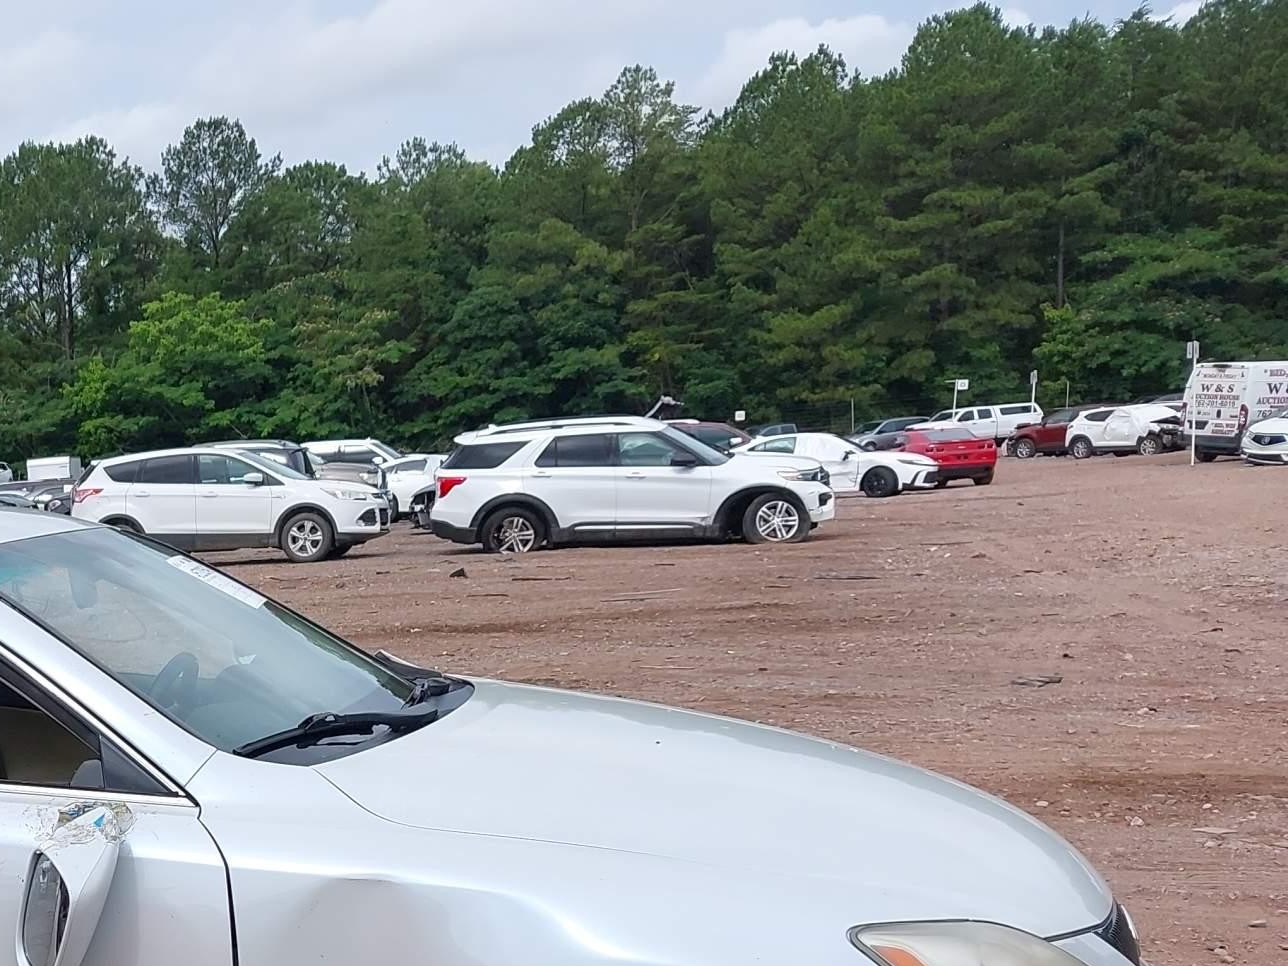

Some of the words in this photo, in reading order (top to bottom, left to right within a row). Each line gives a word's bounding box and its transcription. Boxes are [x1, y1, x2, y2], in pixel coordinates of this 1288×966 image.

[1201, 384, 1214, 392] W
[1215, 384, 1225, 393] &
[1227, 384, 1235, 393] S
[1266, 382, 1284, 395] W
